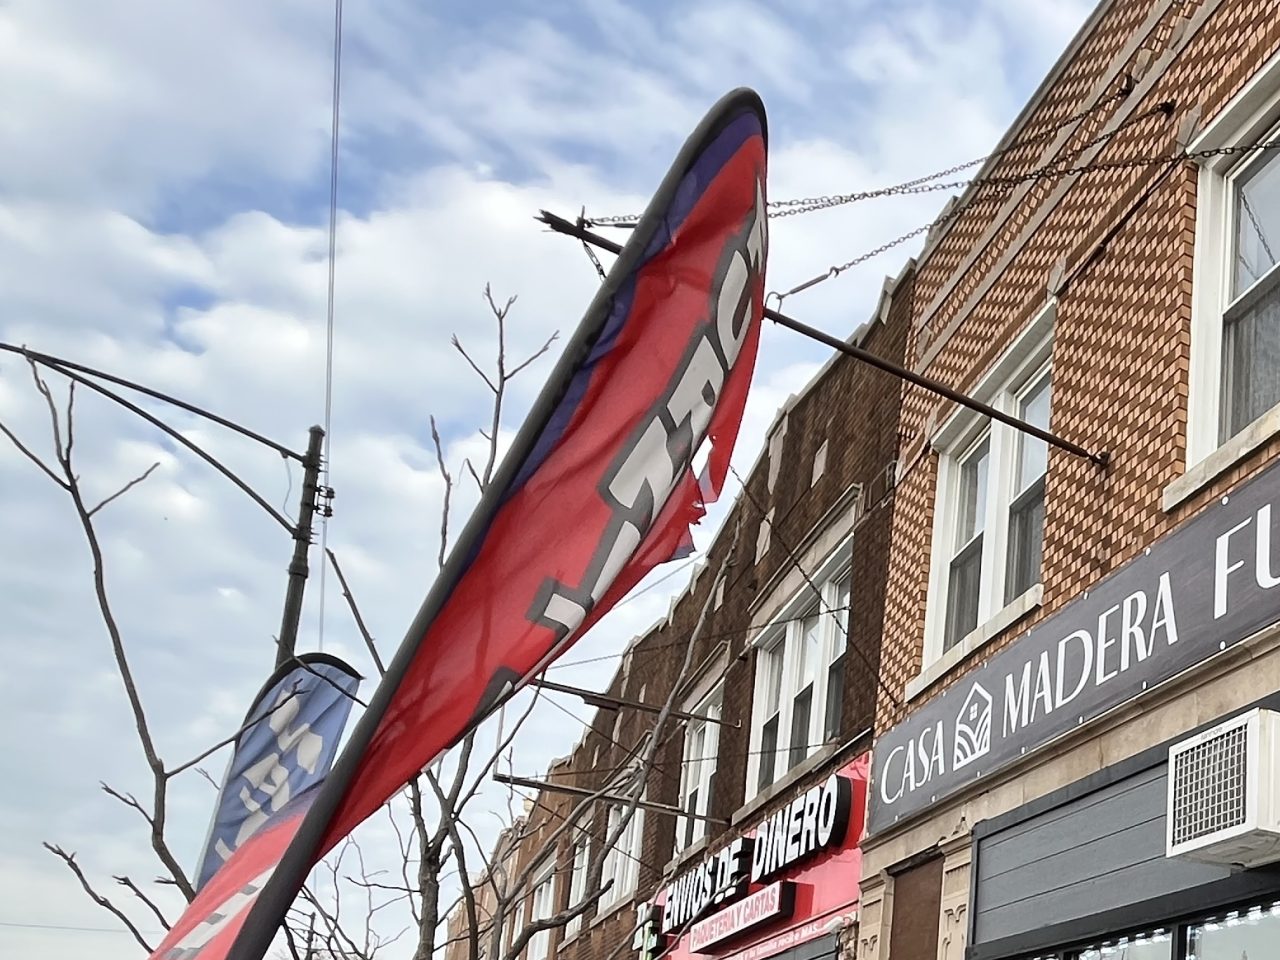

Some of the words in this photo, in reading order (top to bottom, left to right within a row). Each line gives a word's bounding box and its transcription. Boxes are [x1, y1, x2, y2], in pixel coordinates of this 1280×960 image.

[881, 720, 945, 804] CASA
[1002, 572, 1179, 738] MADERA
[662, 855, 716, 934] ENVIOS
[714, 838, 742, 904] DE
[751, 774, 838, 883] DINERO
[743, 888, 777, 923] CARTAS
